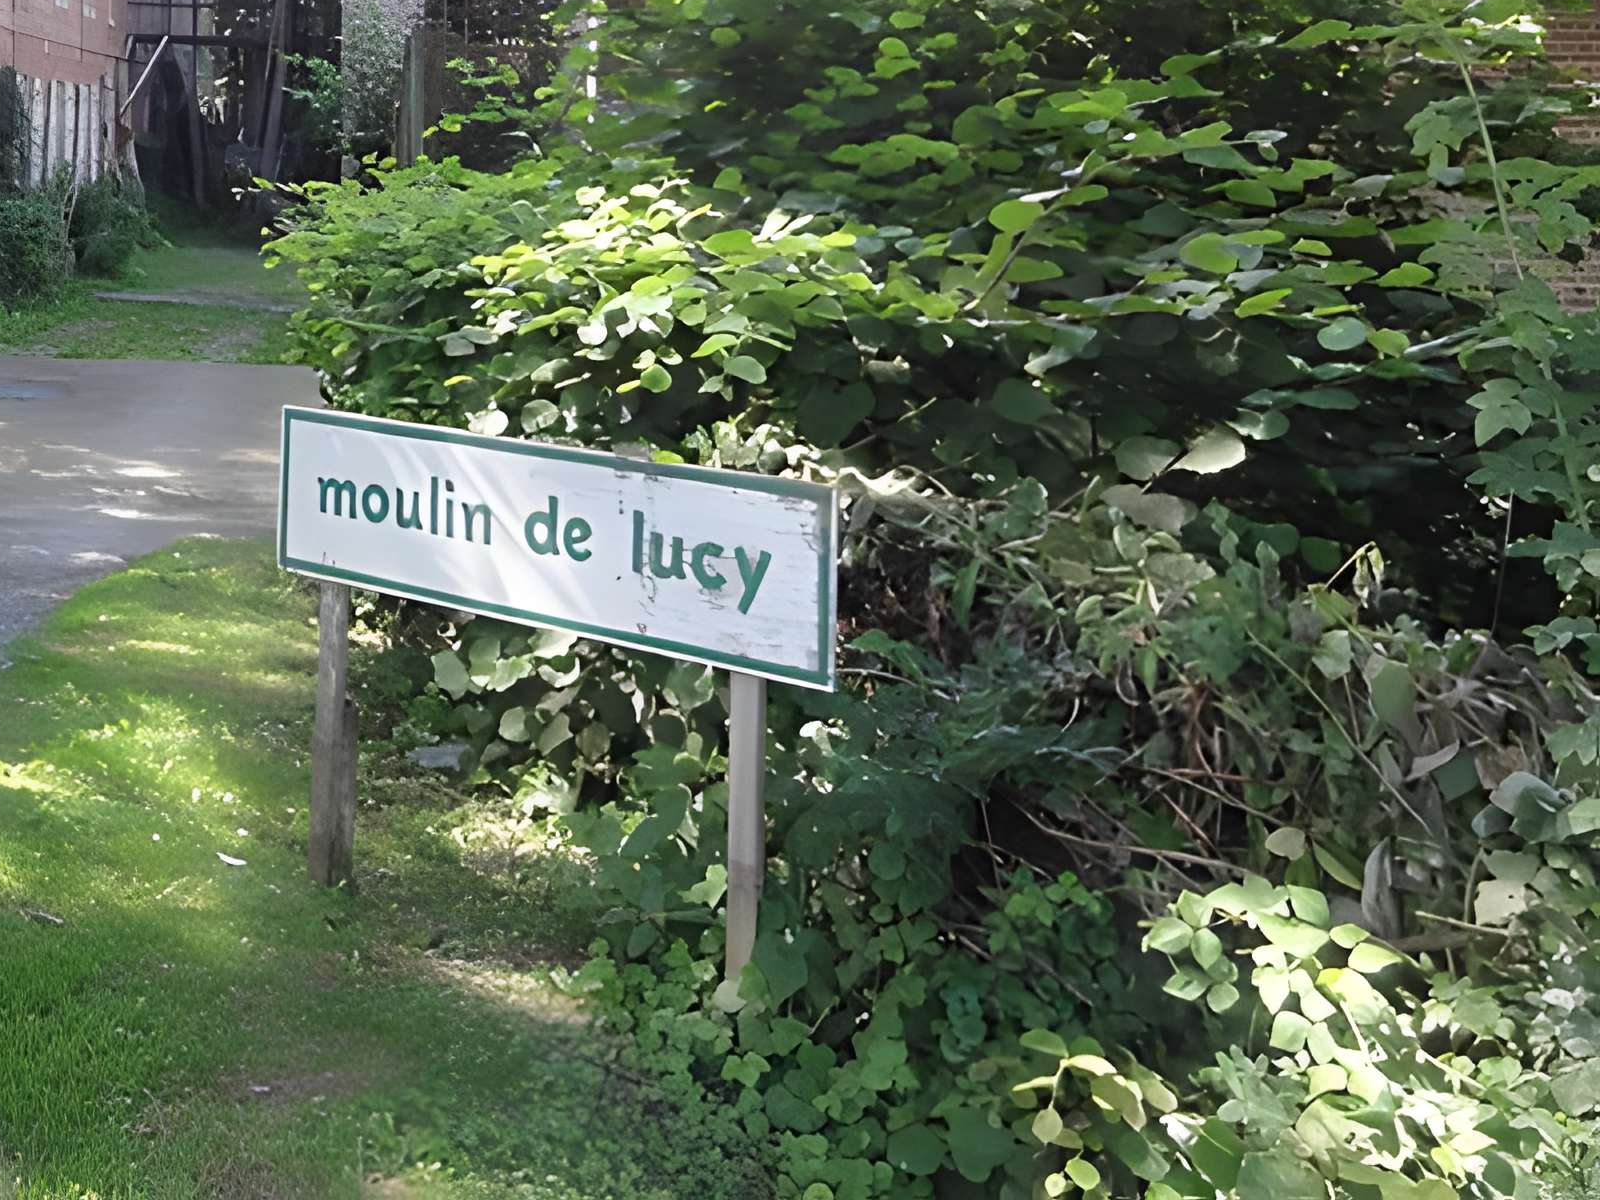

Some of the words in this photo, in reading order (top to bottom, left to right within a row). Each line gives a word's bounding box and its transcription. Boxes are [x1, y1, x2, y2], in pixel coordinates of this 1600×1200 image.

[317, 475, 492, 545] moulin
[524, 495, 593, 562] de
[632, 509, 772, 615] lucy
